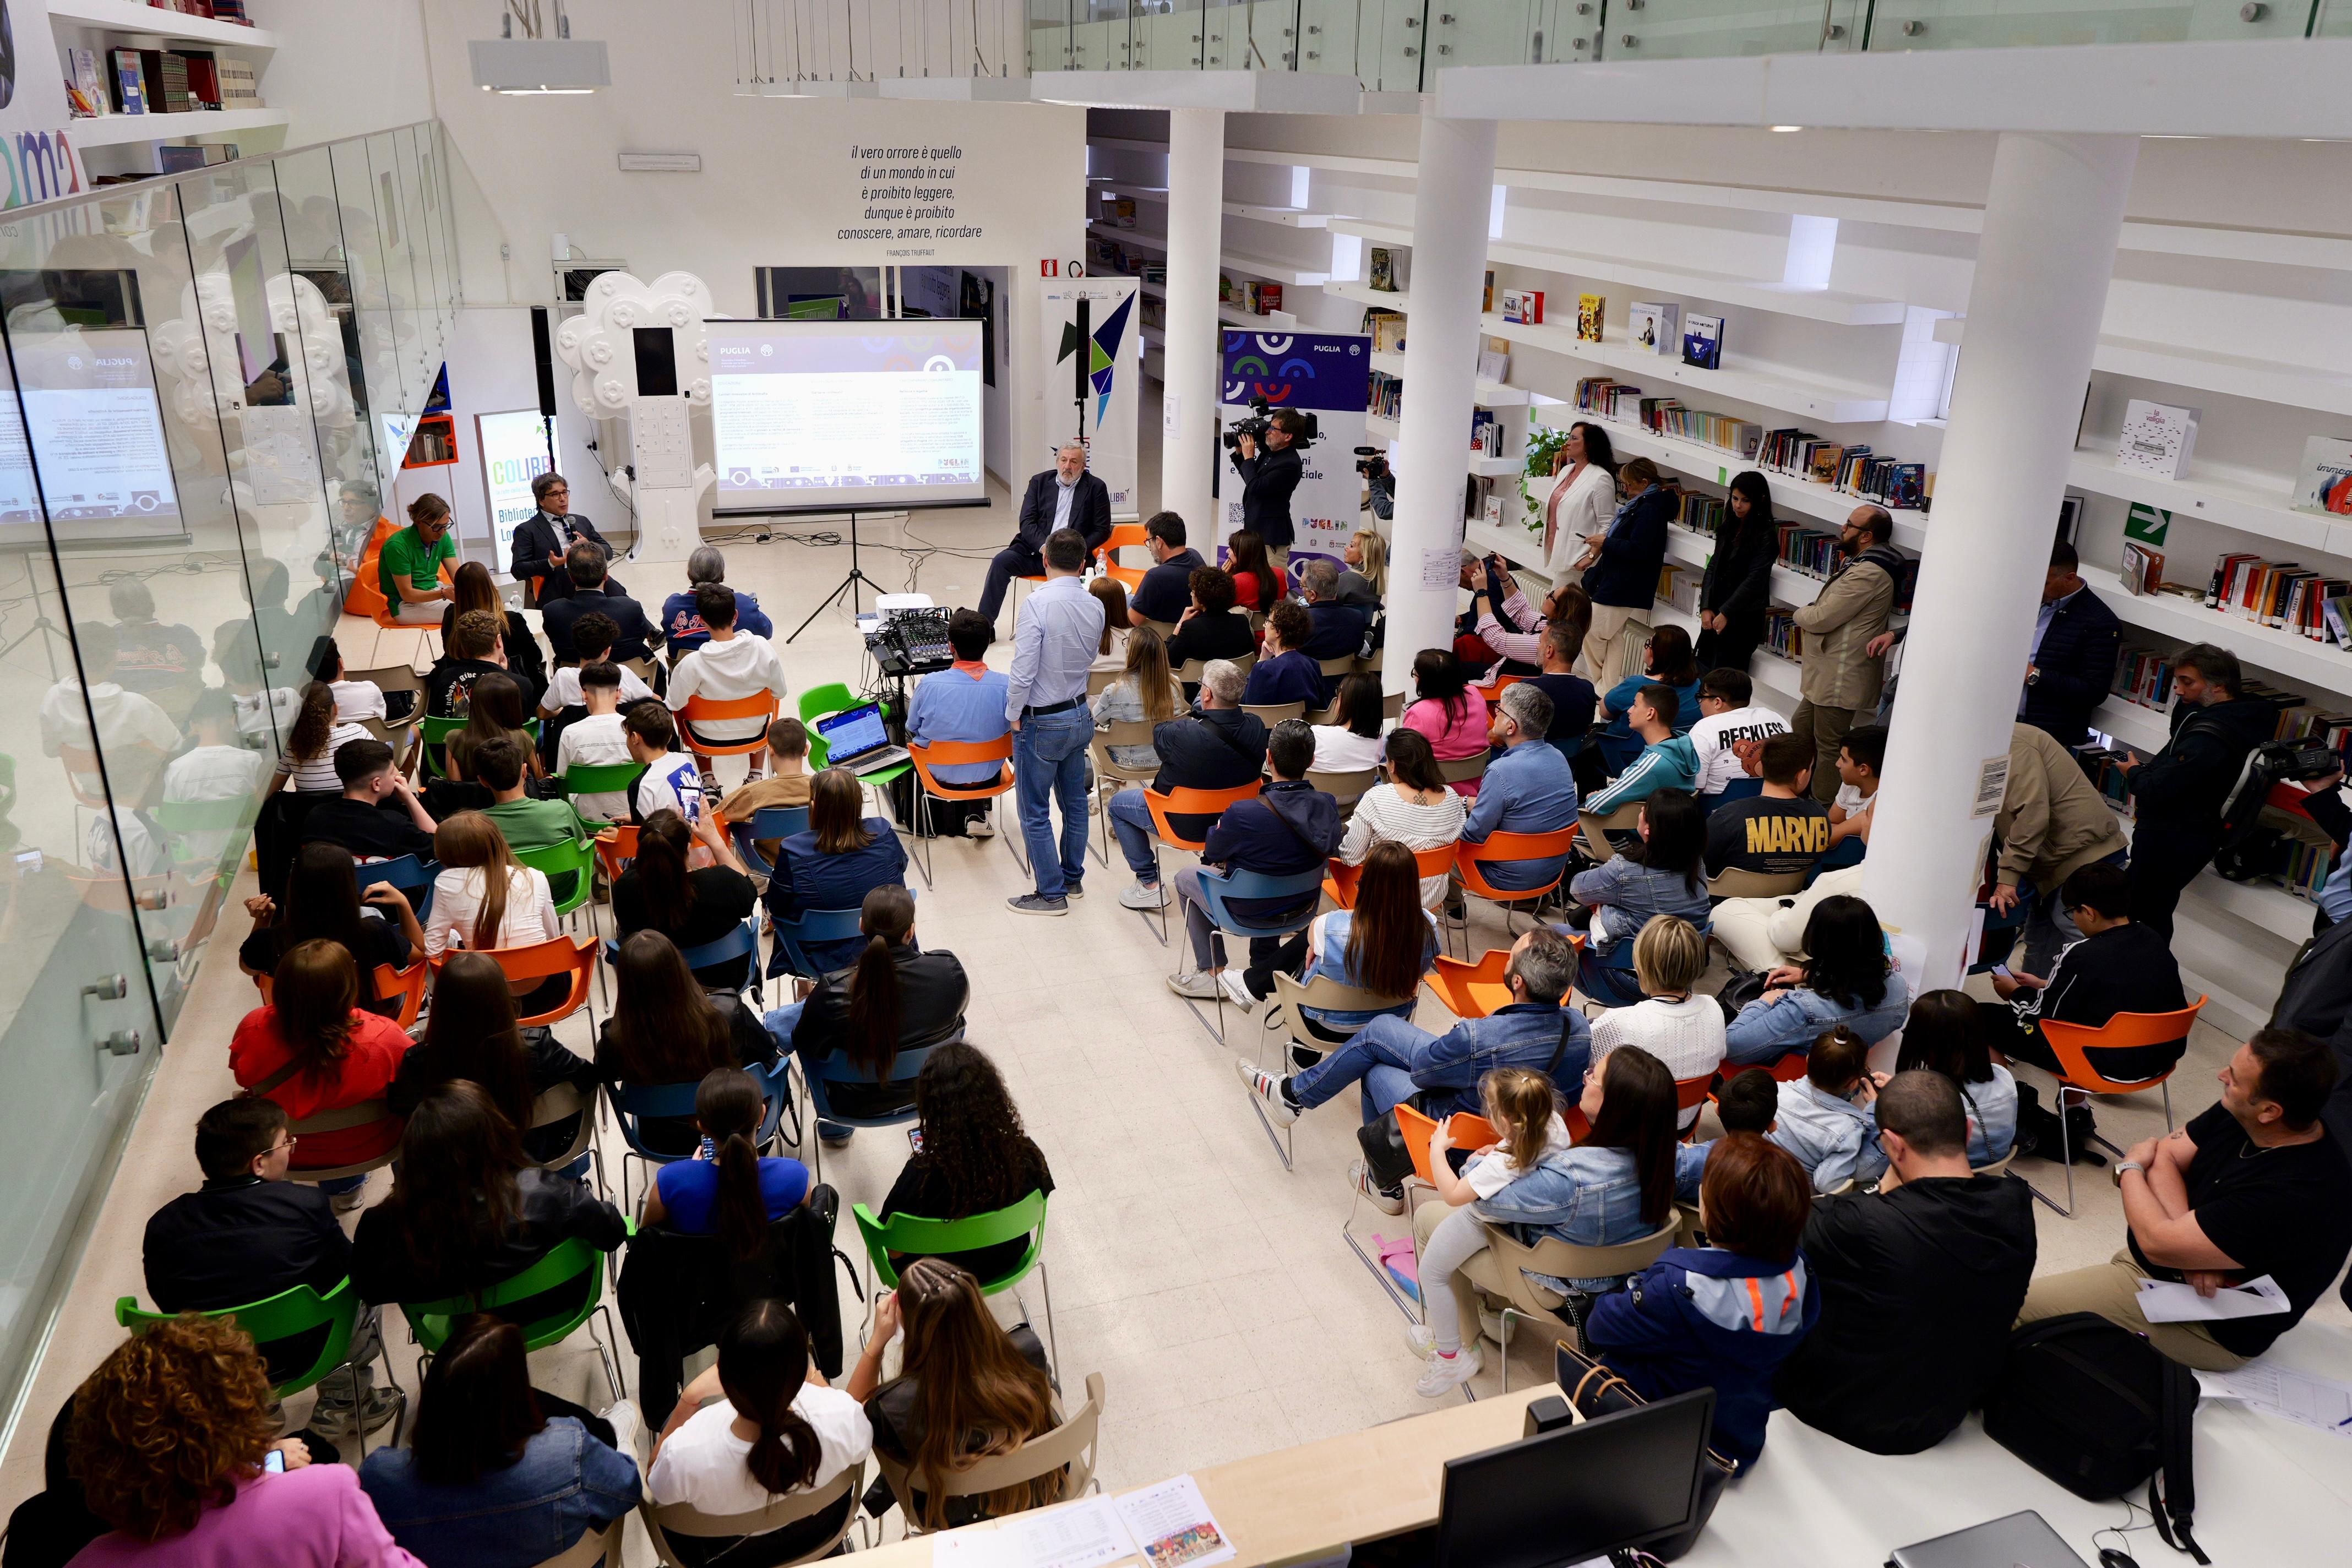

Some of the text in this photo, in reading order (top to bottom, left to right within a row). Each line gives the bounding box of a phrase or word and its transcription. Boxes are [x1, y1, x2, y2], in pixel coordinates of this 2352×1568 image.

[851, 145, 962, 161] il vero orrore è quello
[861, 166, 955, 179] di un mondo in cui
[862, 186, 955, 202] è proibito leggere,
[864, 206, 955, 221] dunque è proibito
[838, 225, 982, 240] conoscere, amare, ricordare
[886, 249, 910, 258] FRANÇOIS
[2147, 416, 2165, 424] valigia
[493, 455, 552, 484] COLIBR
[1110, 492, 1126, 502] LIBRÌ
[498, 507, 538, 523] Bibliotec
[1302, 518, 1348, 531] PUGLIA
[2275, 598, 2284, 615] UCCI
[671, 610, 688, 631] Los
[459, 672, 477, 682] give
[1718, 722, 1785, 750] RECKLESS
[1745, 815, 1830, 853] MARVEL
